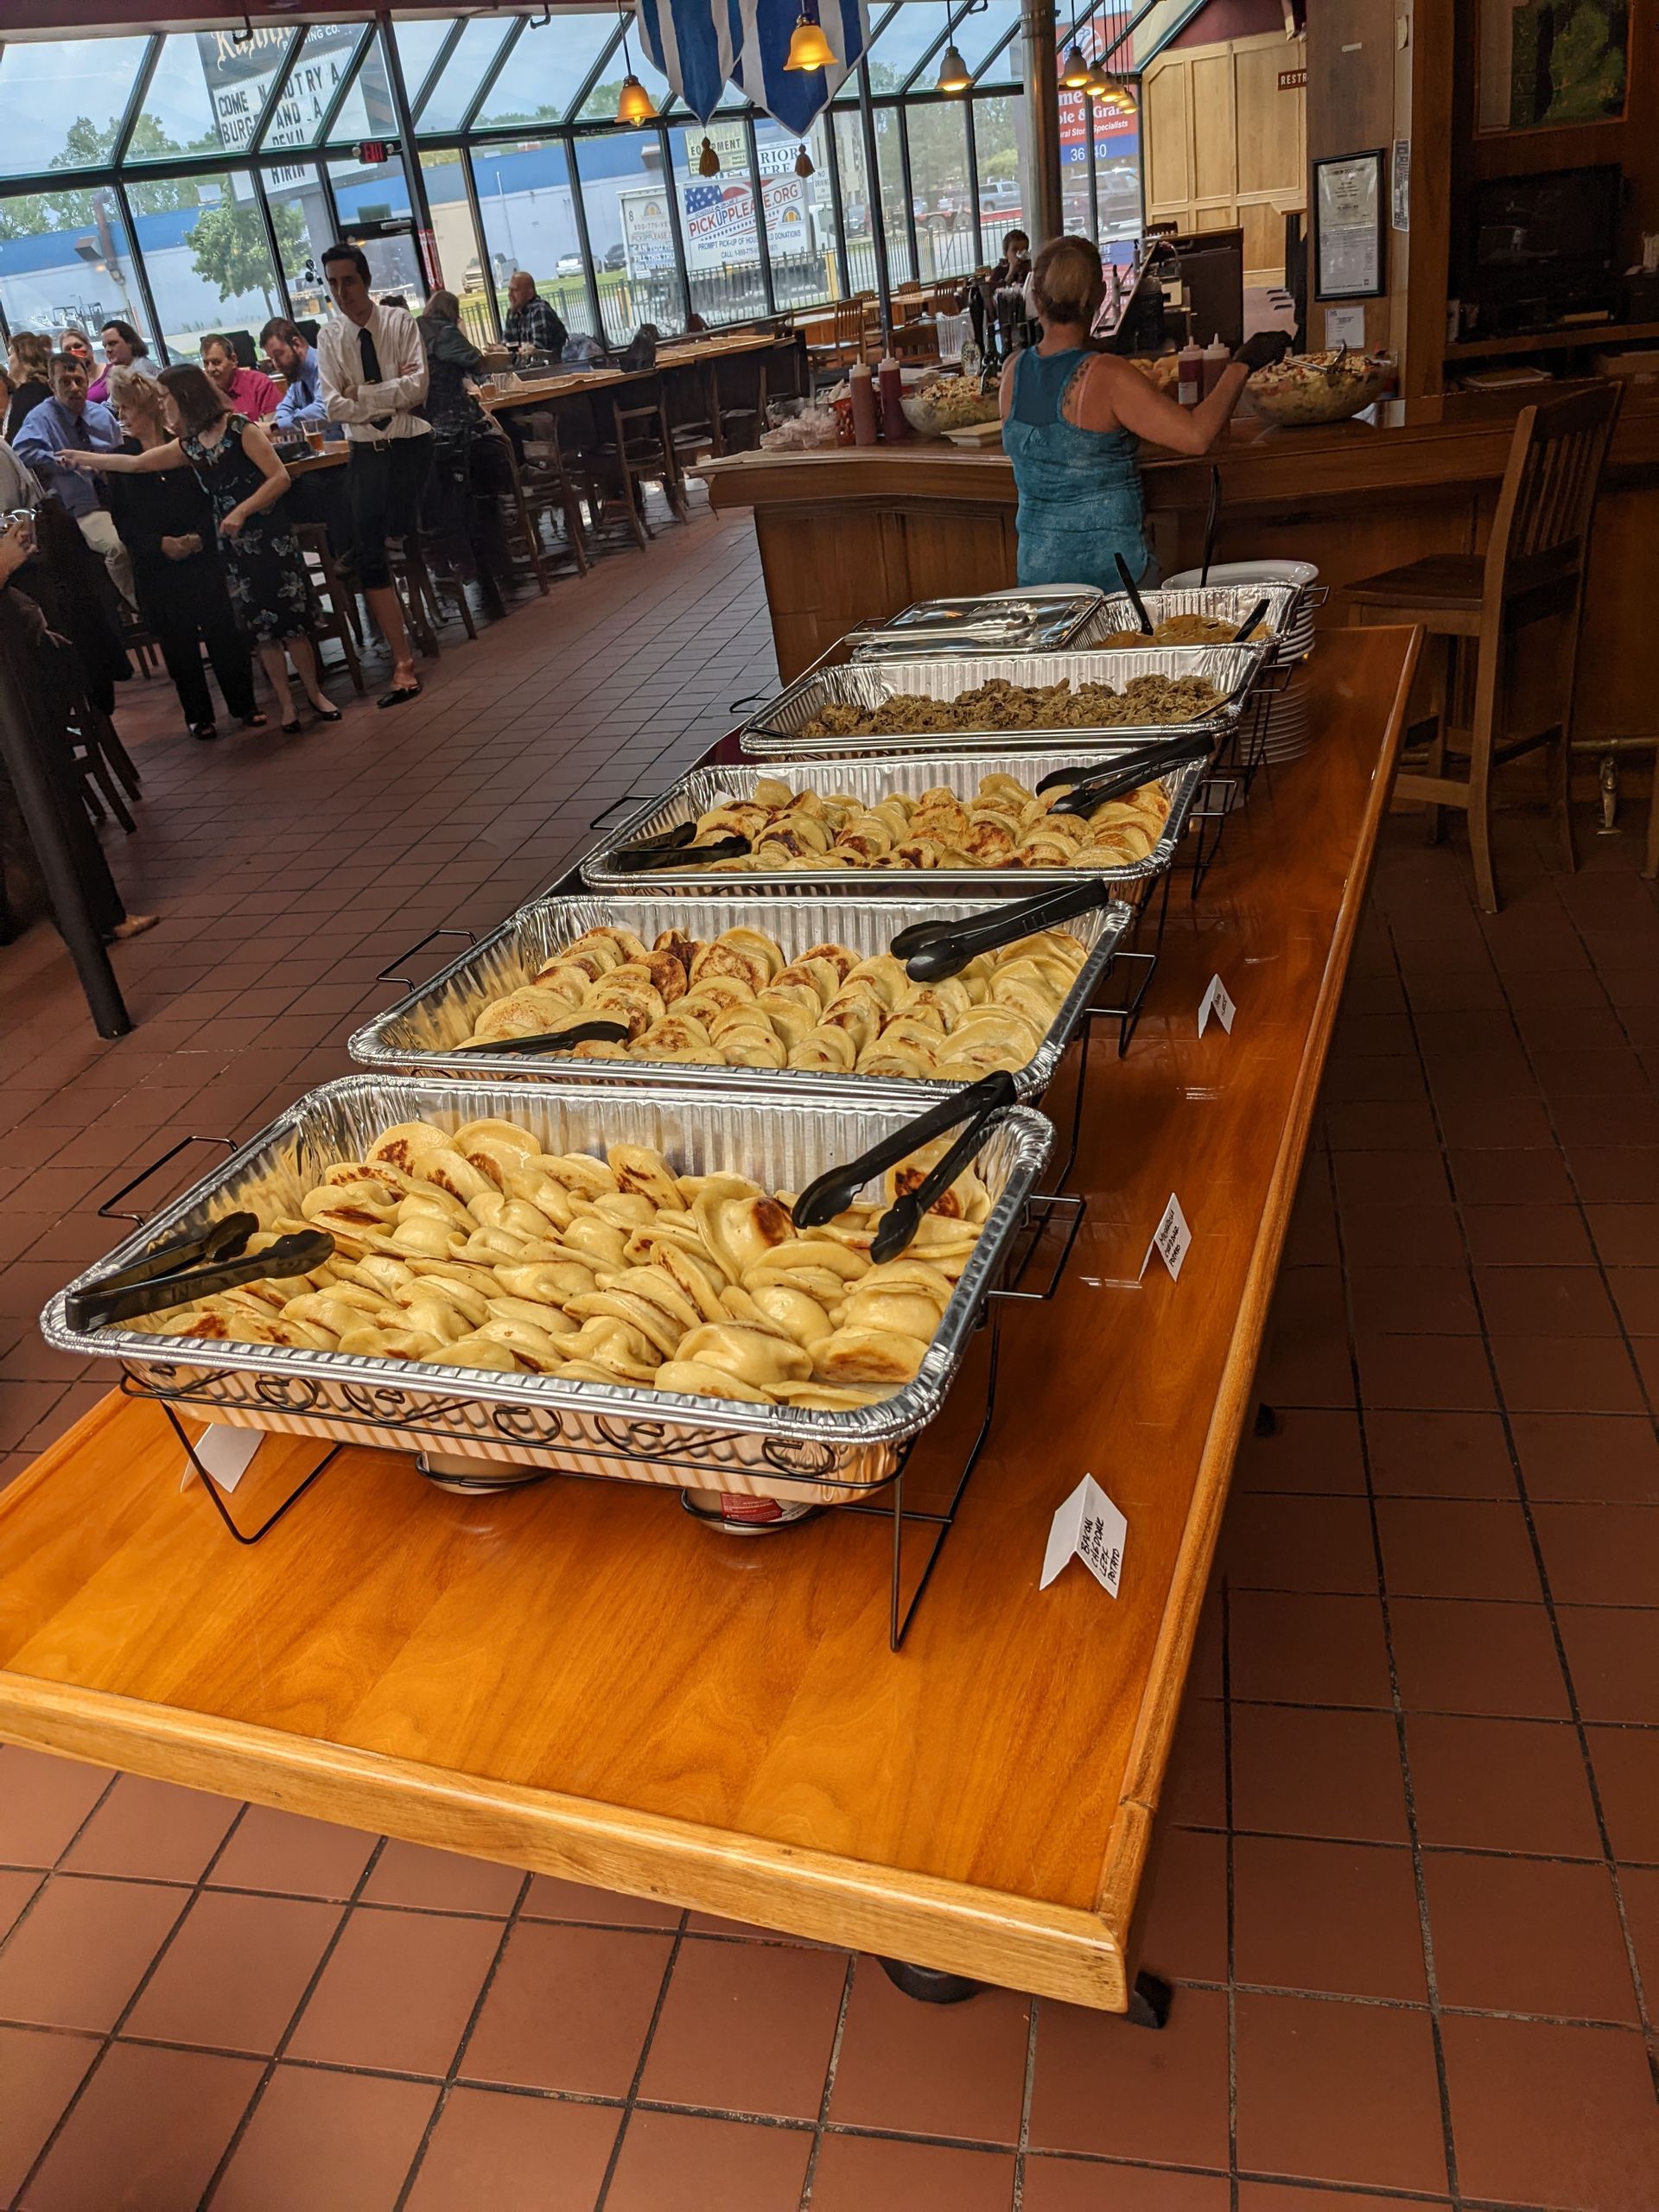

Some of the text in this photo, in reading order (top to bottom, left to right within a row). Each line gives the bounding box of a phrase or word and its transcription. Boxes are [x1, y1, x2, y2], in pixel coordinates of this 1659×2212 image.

[1281, 73, 1306, 86] RESTR
[218, 91, 250, 118] COME
[276, 101, 301, 130] AND
[314, 96, 323, 119] A
[364, 142, 384, 163] EXIT
[760, 148, 798, 164] RIOR
[628, 210, 634, 222] 8
[689, 183, 798, 237] PICKUPPLEAE.ORG
[697, 240, 718, 251] PROMPT
[774, 229, 802, 240] DONATIONS
